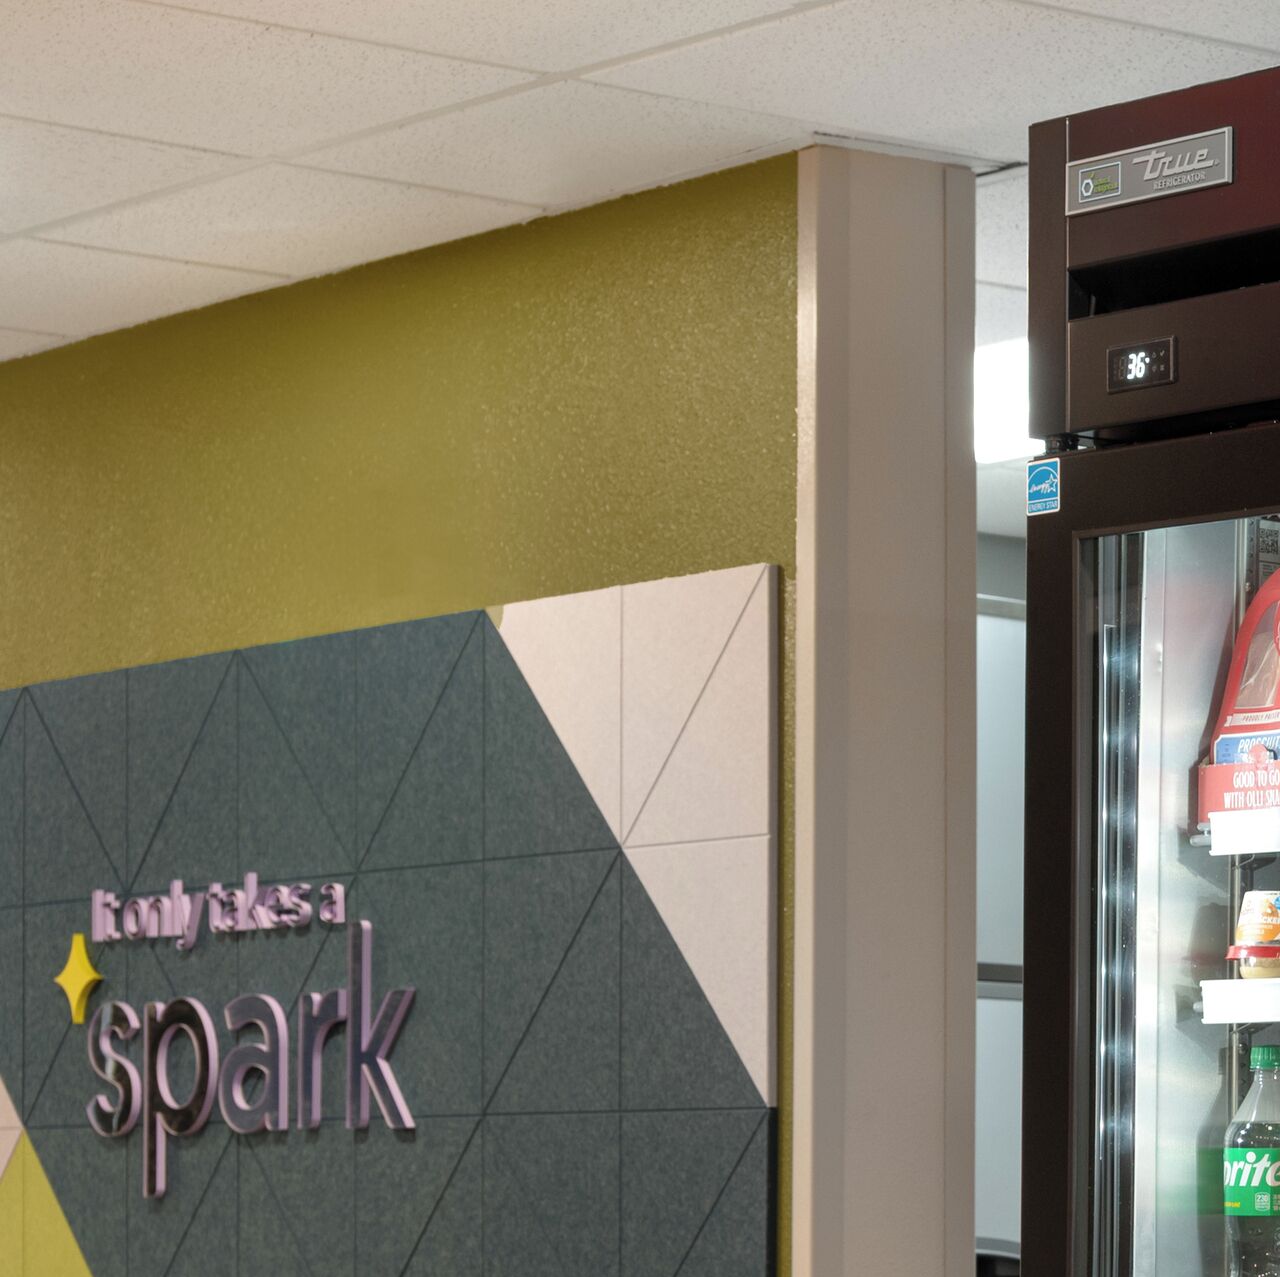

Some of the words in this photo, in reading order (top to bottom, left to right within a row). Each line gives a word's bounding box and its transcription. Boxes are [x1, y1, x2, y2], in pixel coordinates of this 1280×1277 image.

[1132, 149, 1214, 181] true
[1154, 171, 1206, 190] REFRIGERATOR
[1233, 770, 1256, 787] GOOD
[1257, 770, 1267, 786] TO
[1269, 769, 1280, 785] GO
[92, 889, 120, 943] It
[123, 879, 203, 951] only
[208, 872, 311, 934] takes
[320, 882, 345, 923] a
[86, 920, 416, 1198] spark
